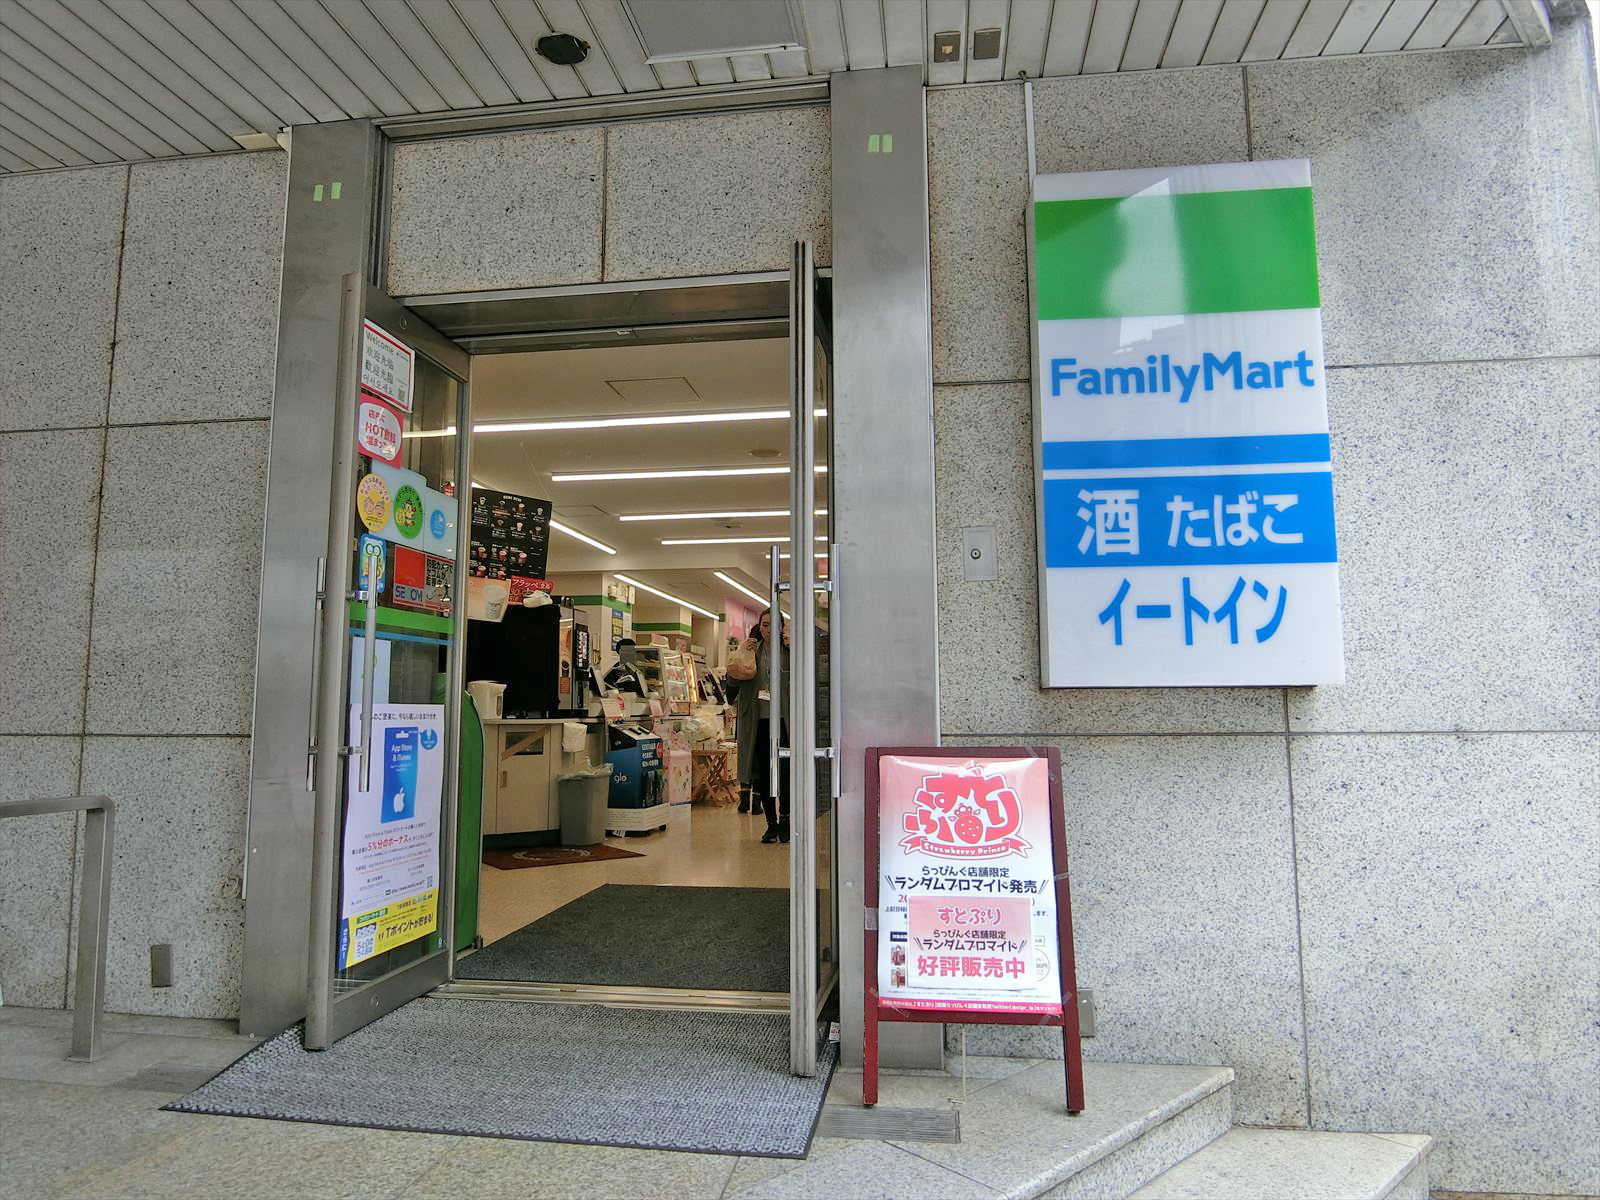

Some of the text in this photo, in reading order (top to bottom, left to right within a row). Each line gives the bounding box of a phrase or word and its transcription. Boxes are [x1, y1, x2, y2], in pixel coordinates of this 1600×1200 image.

[366, 330, 394, 355] Welcome
[1050, 350, 1315, 403] FamilyMart
[1076, 489, 1304, 556] 酒 たばこ
[362, 560, 382, 581] AD
[395, 586, 422, 602] SEOM
[1098, 576, 1288, 646] イートイン
[613, 772, 627, 783] glo
[923, 842, 1006, 856] Strawberry Prince
[921, 865, 1010, 878] らっぴんぐ店舗限定
[937, 907, 1003, 925] すとぷり
[933, 929, 1007, 940] らっぴんぐ店舗限定
[917, 955, 1025, 979] 好評販売中
